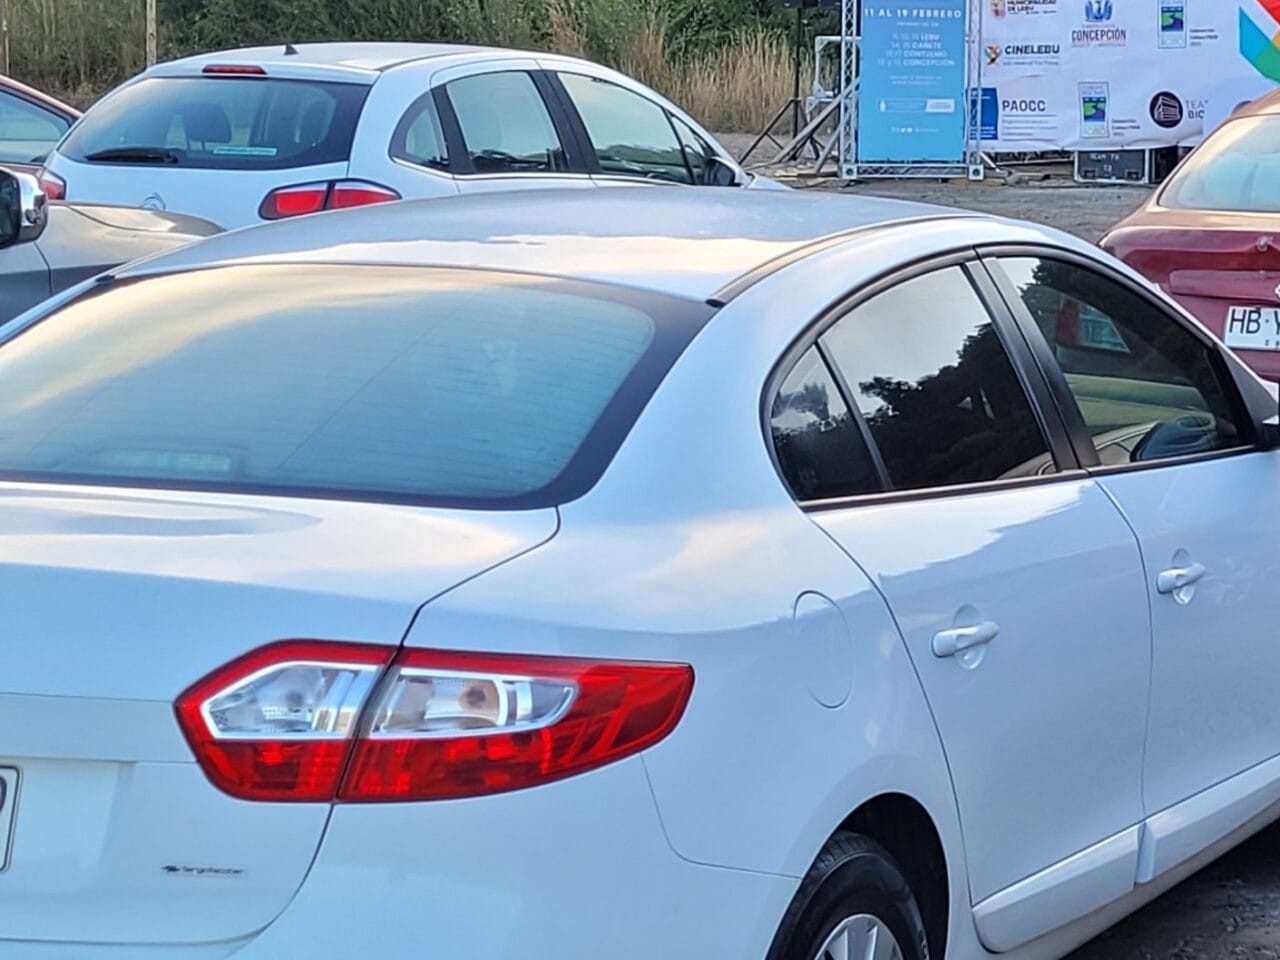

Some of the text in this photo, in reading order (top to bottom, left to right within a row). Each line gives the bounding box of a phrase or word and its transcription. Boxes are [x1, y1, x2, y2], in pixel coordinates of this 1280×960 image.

[879, 9, 892, 17] AL
[897, 9, 908, 17] 19
[912, 9, 962, 18] FEBRERO
[1071, 28, 1127, 42] CONCEPCIÓN
[1004, 44, 1060, 55] CINELEBU
[1002, 100, 1046, 112] PAOCC
